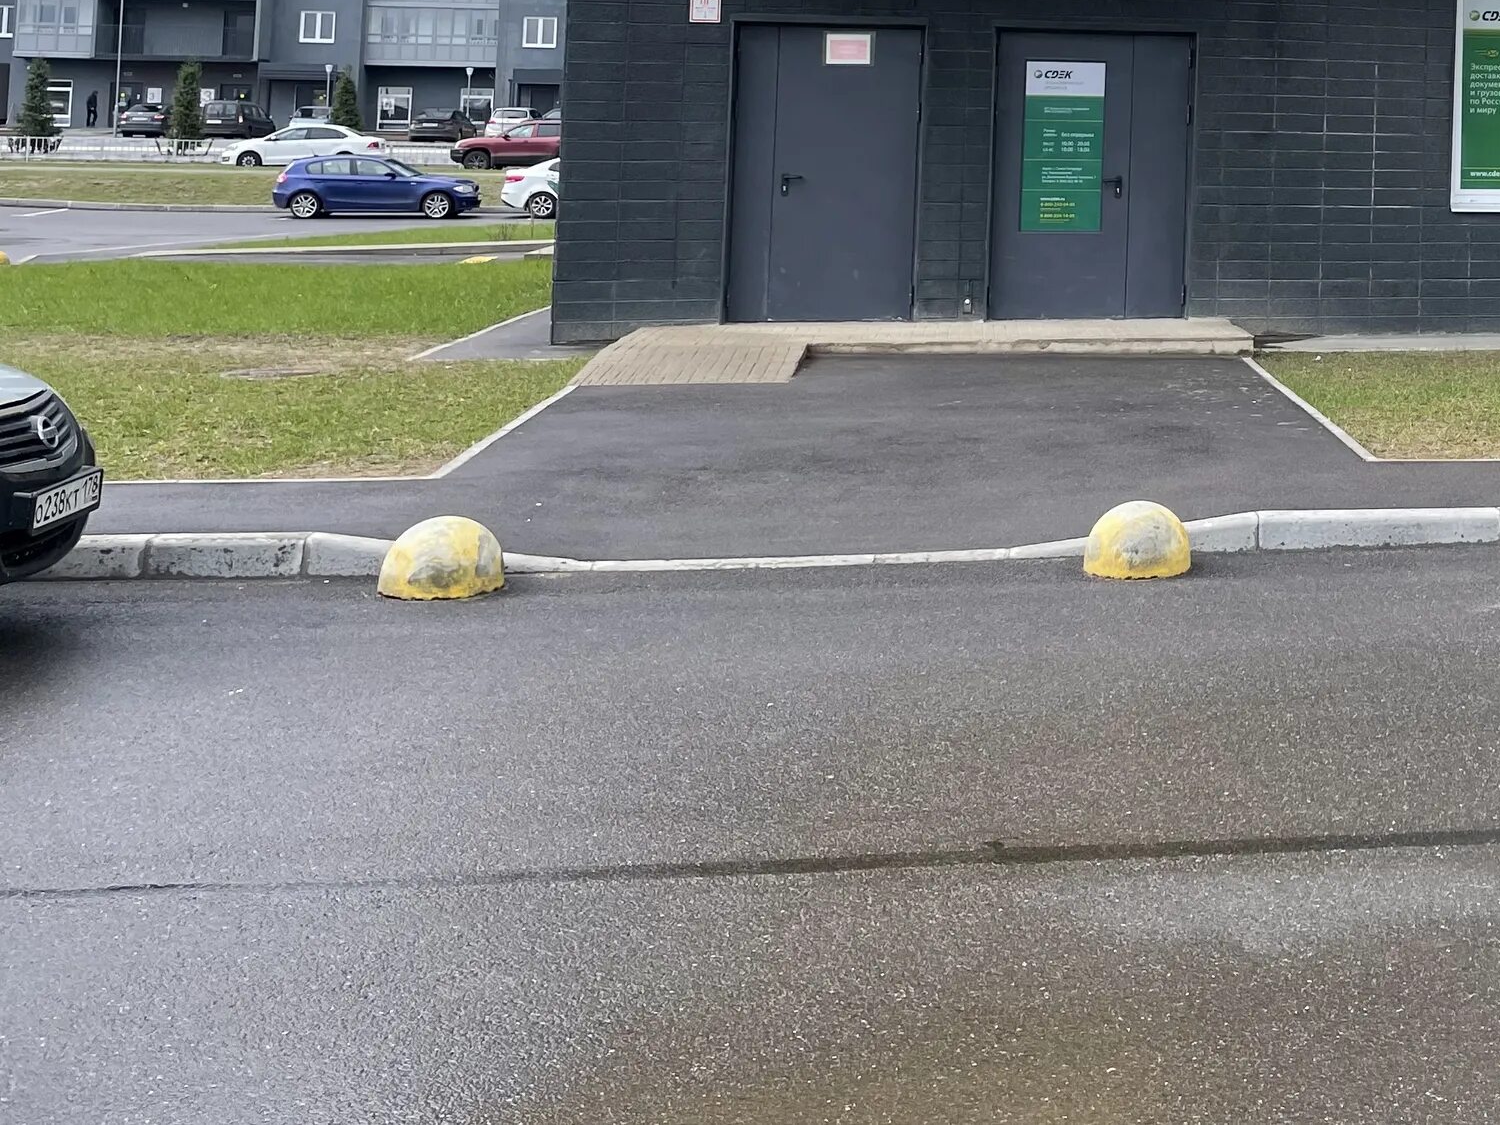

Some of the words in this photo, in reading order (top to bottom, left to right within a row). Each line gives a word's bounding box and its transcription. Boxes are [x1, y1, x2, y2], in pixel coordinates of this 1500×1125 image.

[1044, 70, 1073, 79] CDEK
[1477, 107, 1497, 115] миру
[82, 475, 98, 497] 178
